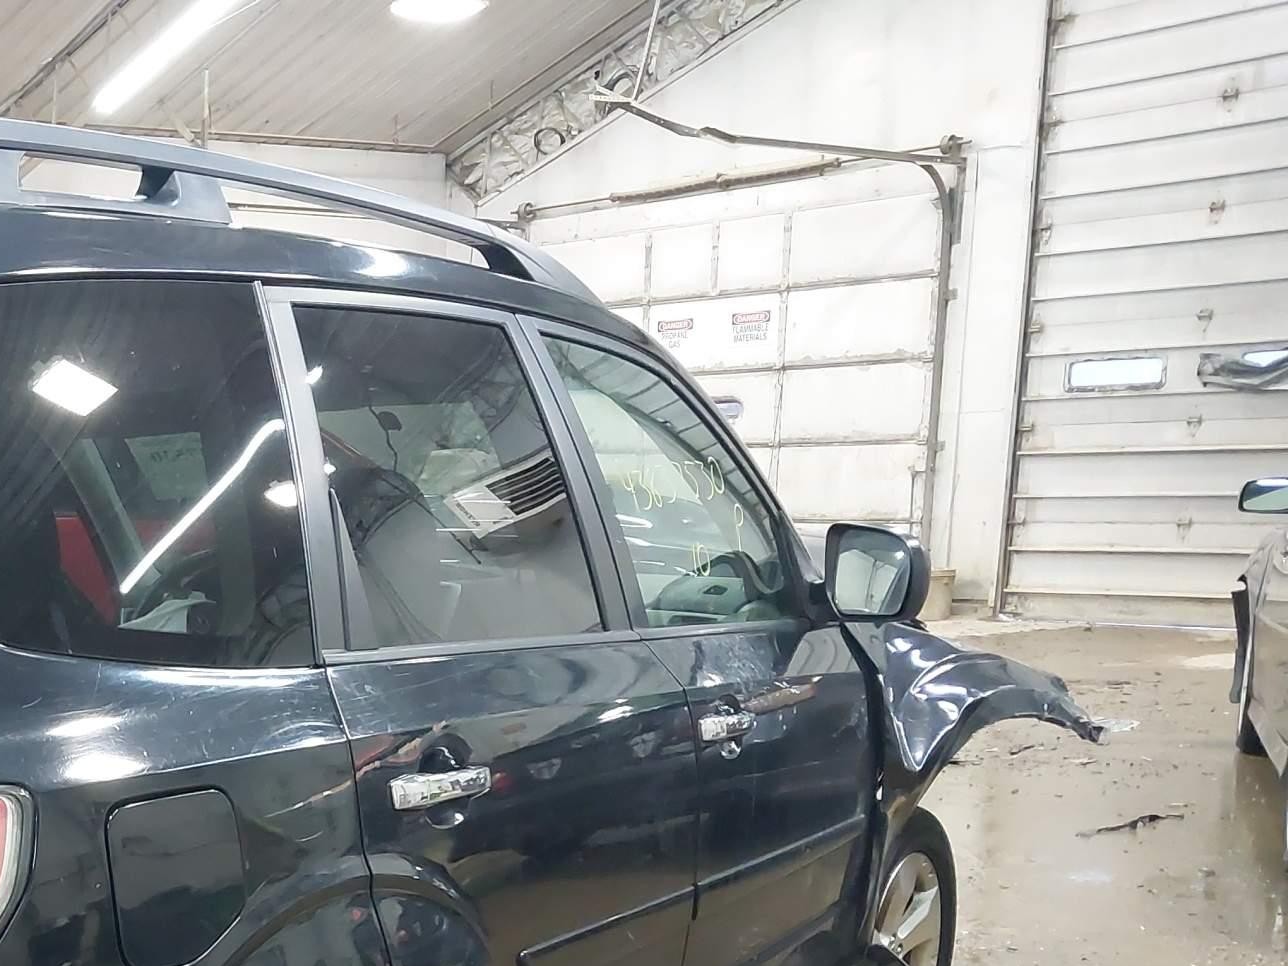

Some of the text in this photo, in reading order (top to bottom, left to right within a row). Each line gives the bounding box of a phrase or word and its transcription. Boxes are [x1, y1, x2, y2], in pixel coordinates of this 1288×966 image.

[738, 314, 765, 323] DANGER
[662, 321, 689, 330] DANGER
[733, 323, 768, 334] FLAMMABLE
[662, 332, 688, 340] PROPANE
[734, 333, 767, 343] MATERIALS
